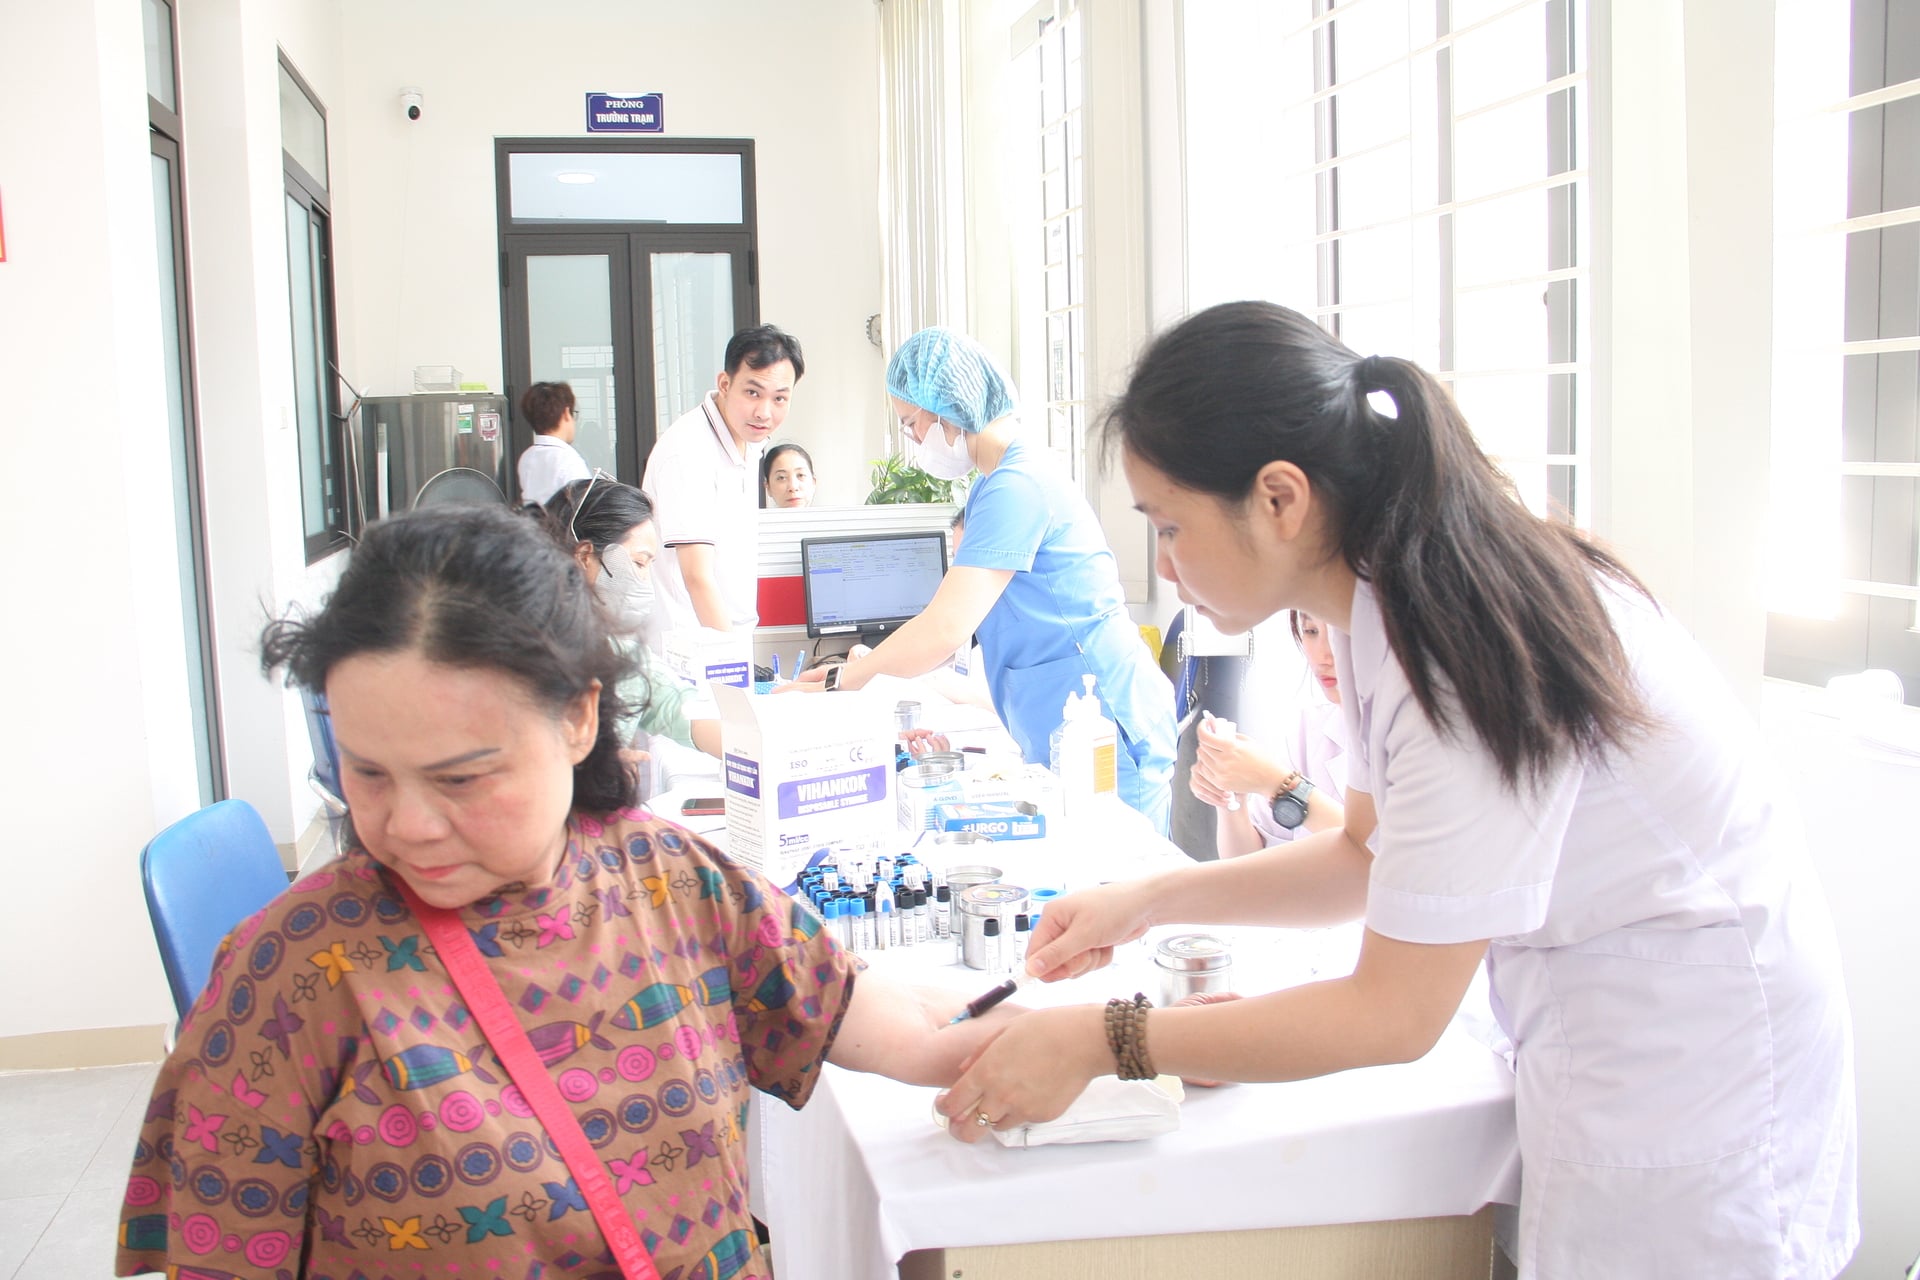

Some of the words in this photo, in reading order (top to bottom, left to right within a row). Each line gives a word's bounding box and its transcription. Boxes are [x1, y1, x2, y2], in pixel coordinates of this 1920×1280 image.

[605, 98, 644, 109] PHÒNG
[630, 113, 654, 125] TRẠM
[789, 759, 808, 770] ISO
[797, 773, 869, 802] VIHANKOK
[971, 821, 1008, 834] URGO
